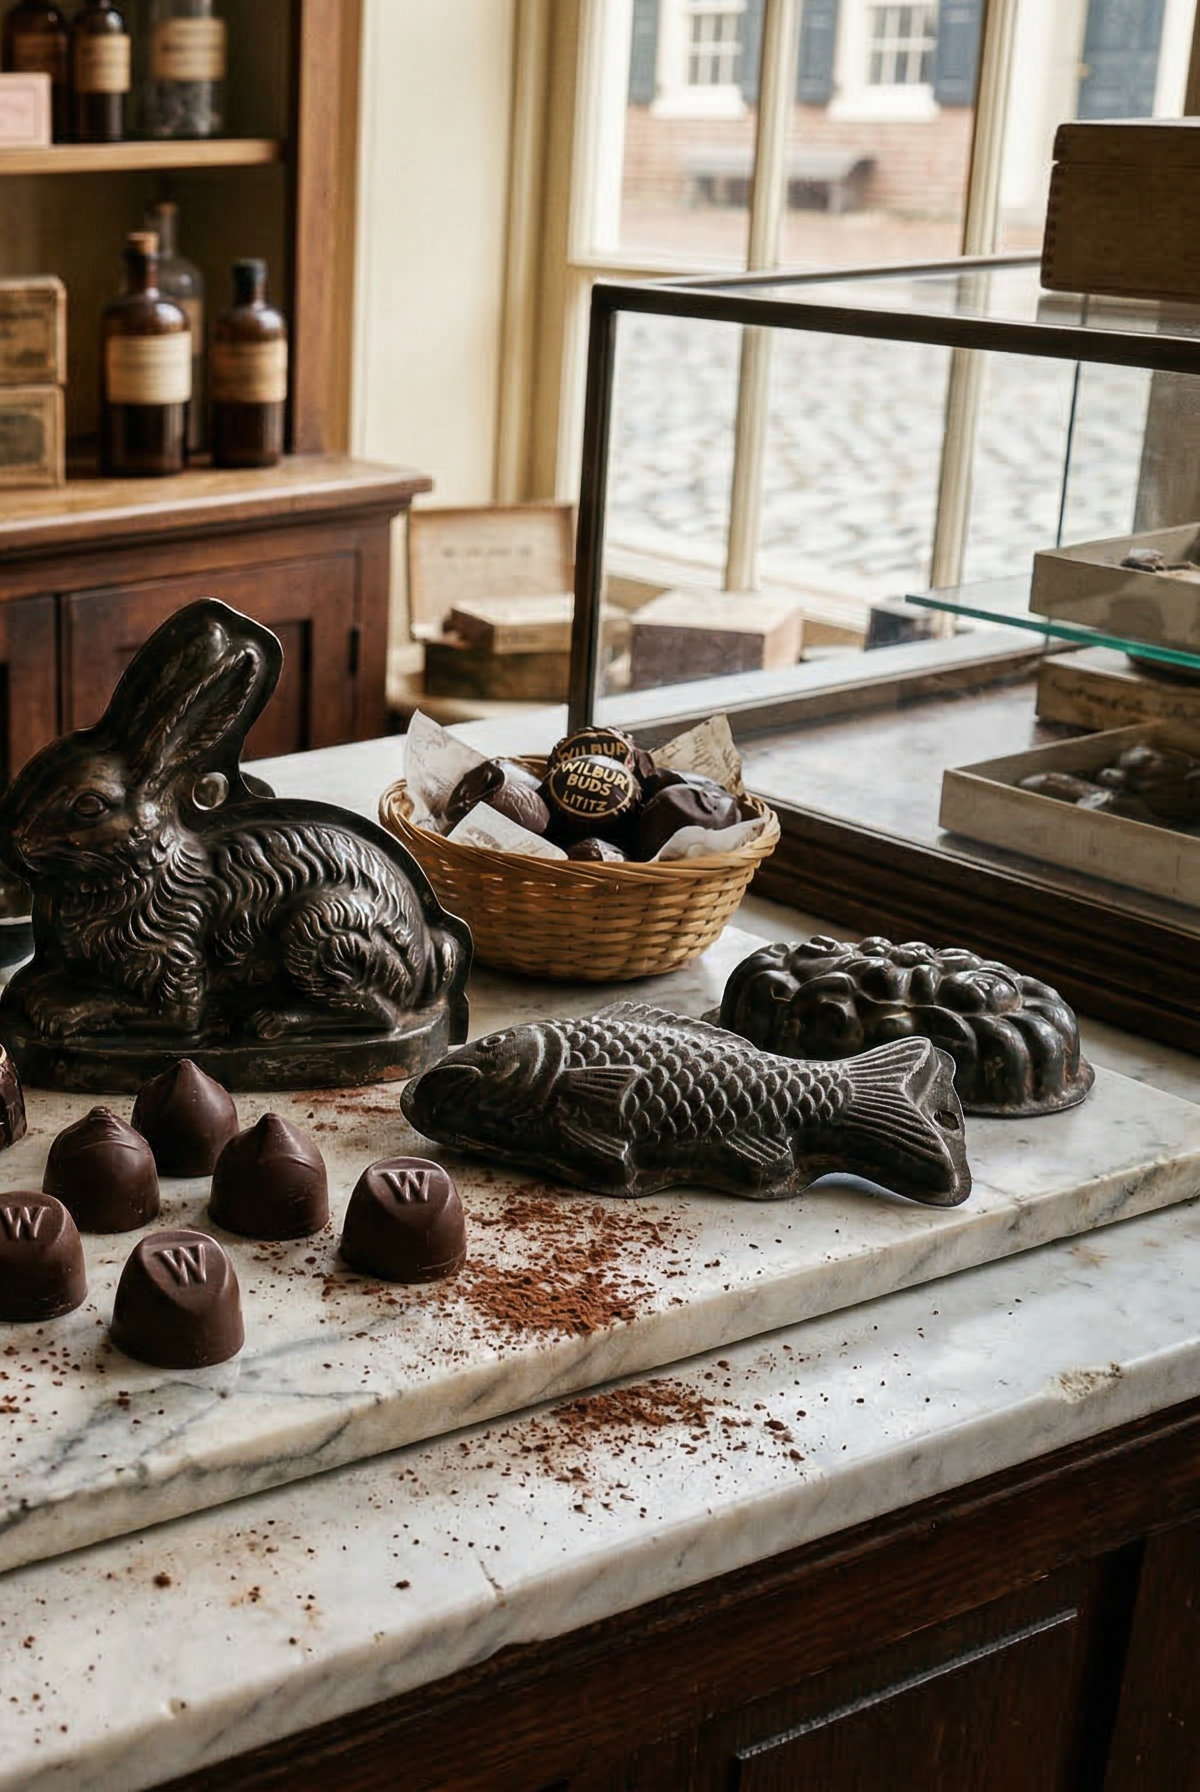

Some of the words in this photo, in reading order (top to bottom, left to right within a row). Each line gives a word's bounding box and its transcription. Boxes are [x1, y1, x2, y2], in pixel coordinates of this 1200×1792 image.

[561, 761, 628, 790] WILBUR
[566, 773, 612, 796] BUDS
[563, 790, 608, 811] LITITZ
[381, 1170, 430, 1203] W
[155, 1243, 207, 1286] W
